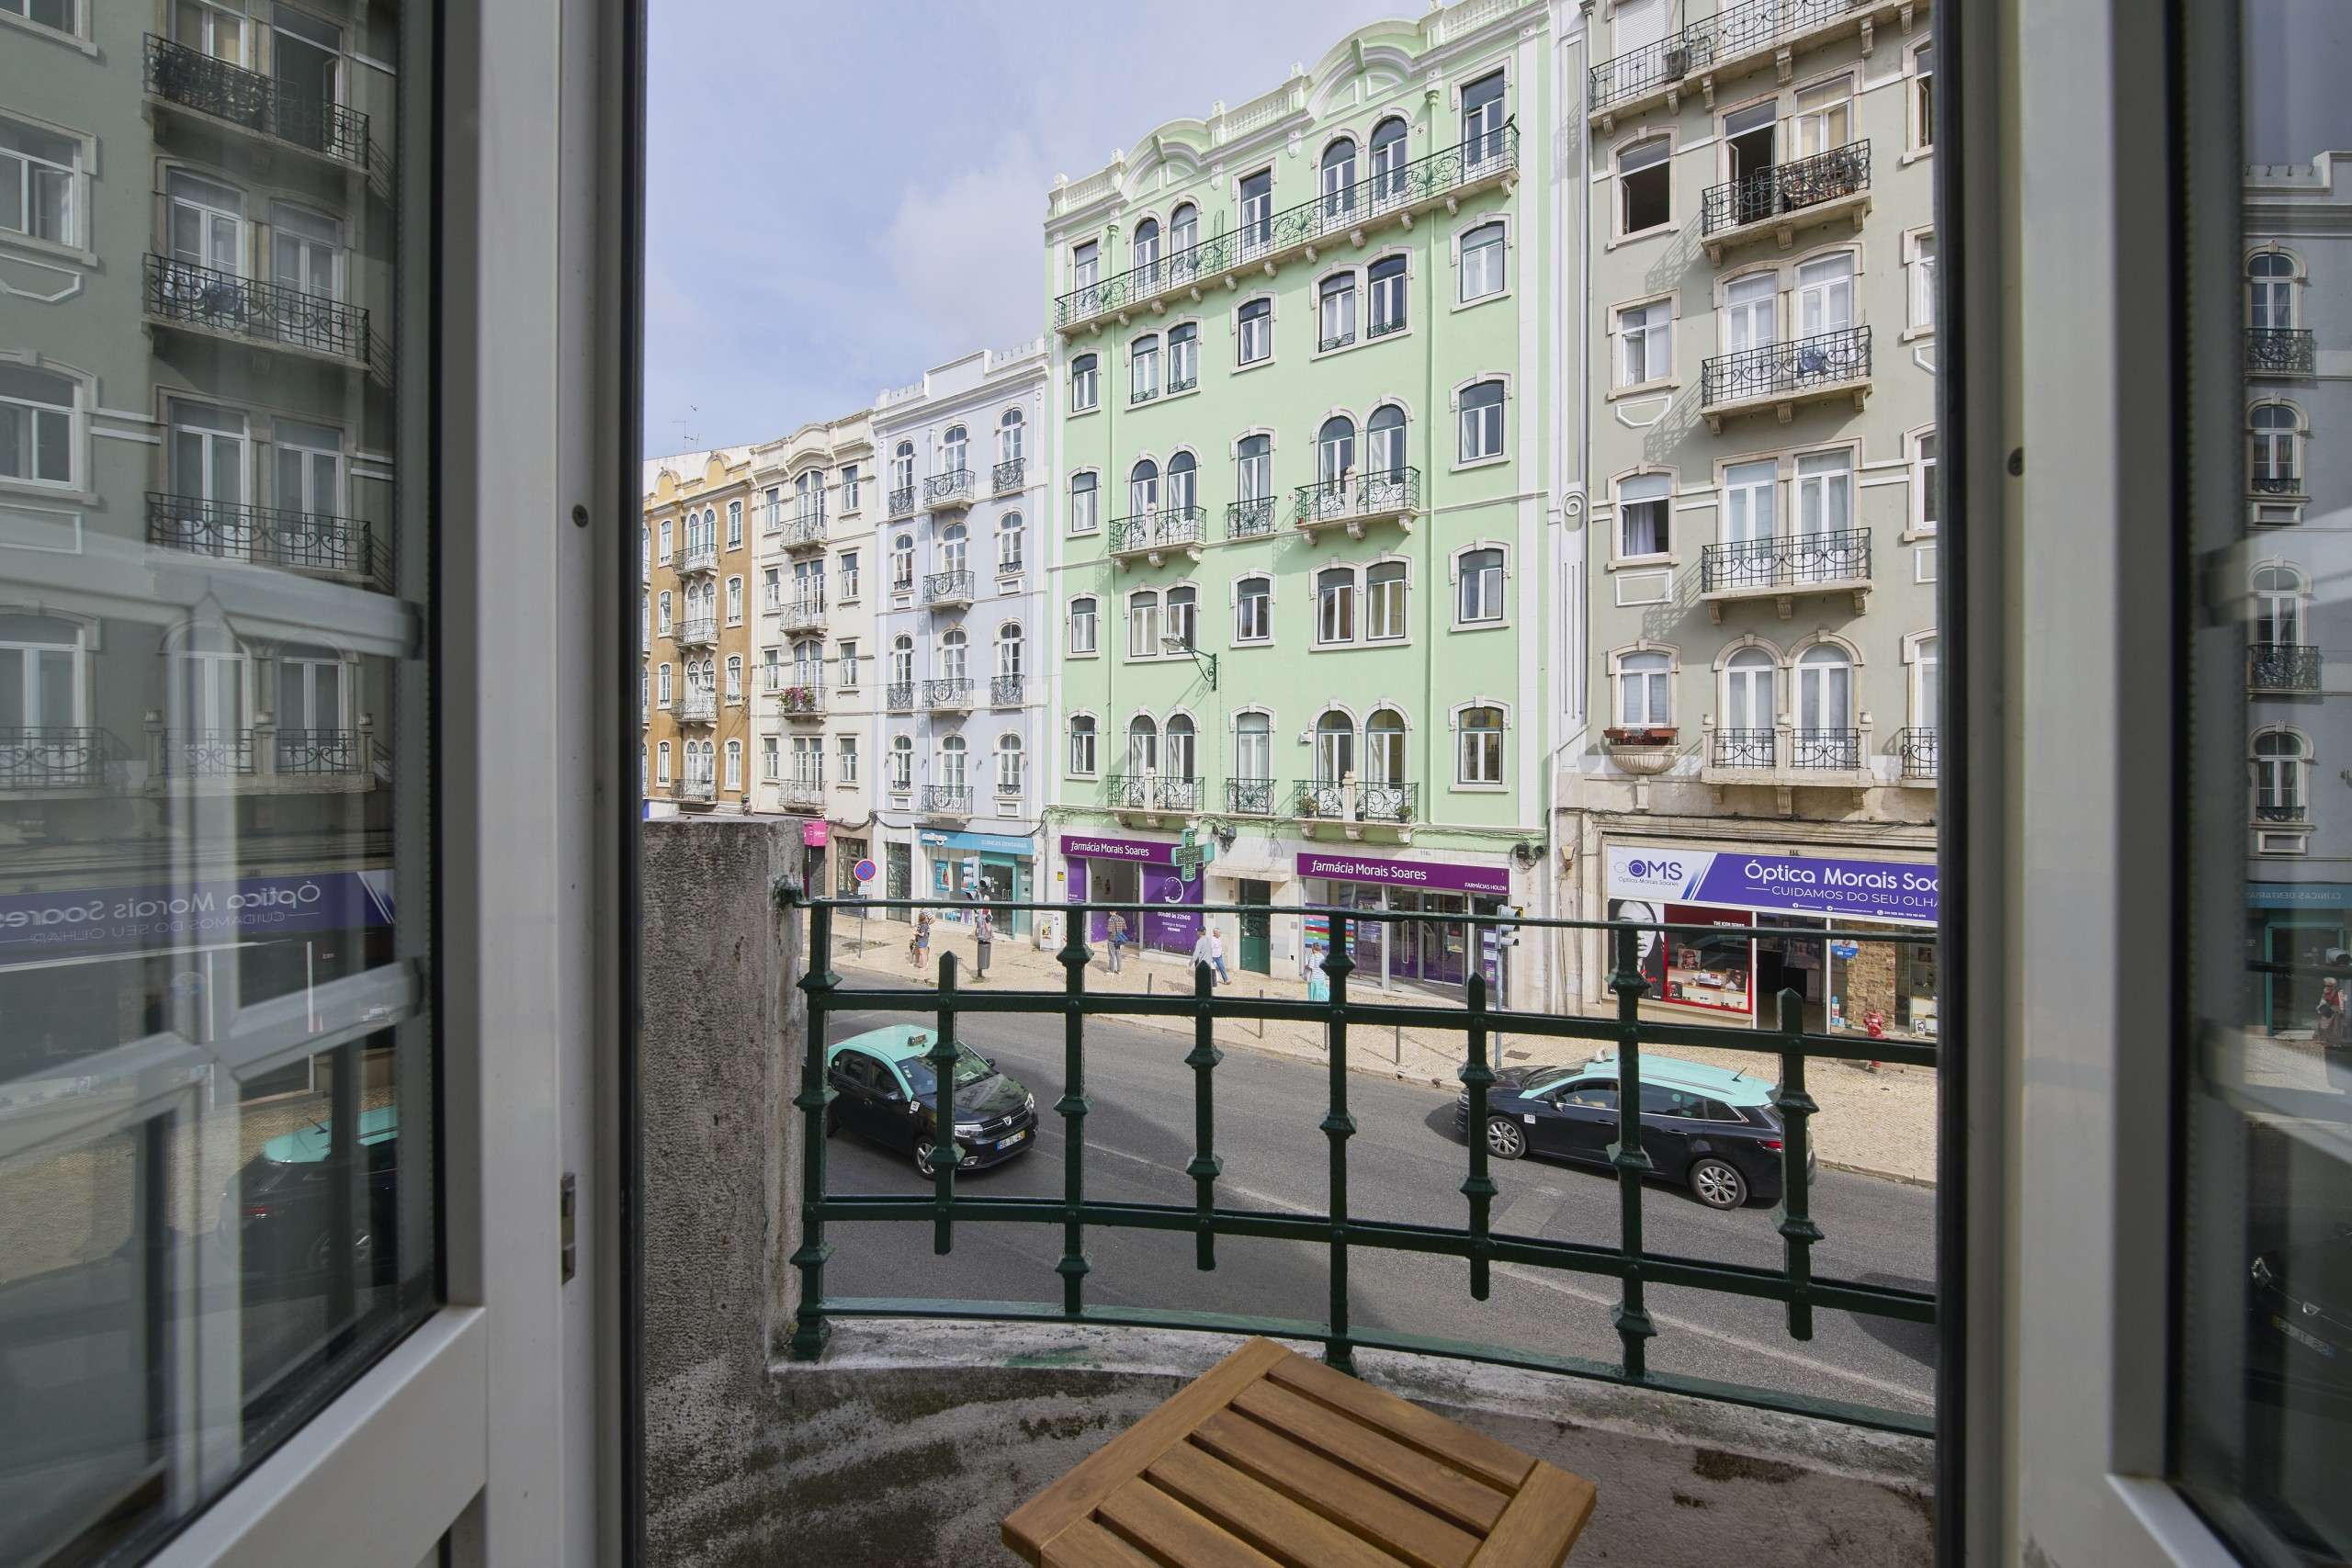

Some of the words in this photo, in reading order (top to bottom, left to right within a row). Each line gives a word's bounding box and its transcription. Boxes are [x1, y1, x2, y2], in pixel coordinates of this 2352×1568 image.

[1069, 840, 1100, 852] farmácia
[1101, 843, 1124, 854] Morais
[1125, 845, 1149, 856] Soares
[1311, 860, 1354, 874] farmácia
[1355, 863, 1388, 877] Morais
[1390, 866, 1427, 880] Soares
[1628, 859, 1683, 880] OMS
[1745, 859, 1816, 885] Óptica
[1824, 867, 1897, 889] Morais
[1771, 886, 1843, 900] CUIDAMOS
[1847, 891, 1868, 902] DO
[1871, 893, 1899, 904] SEU
